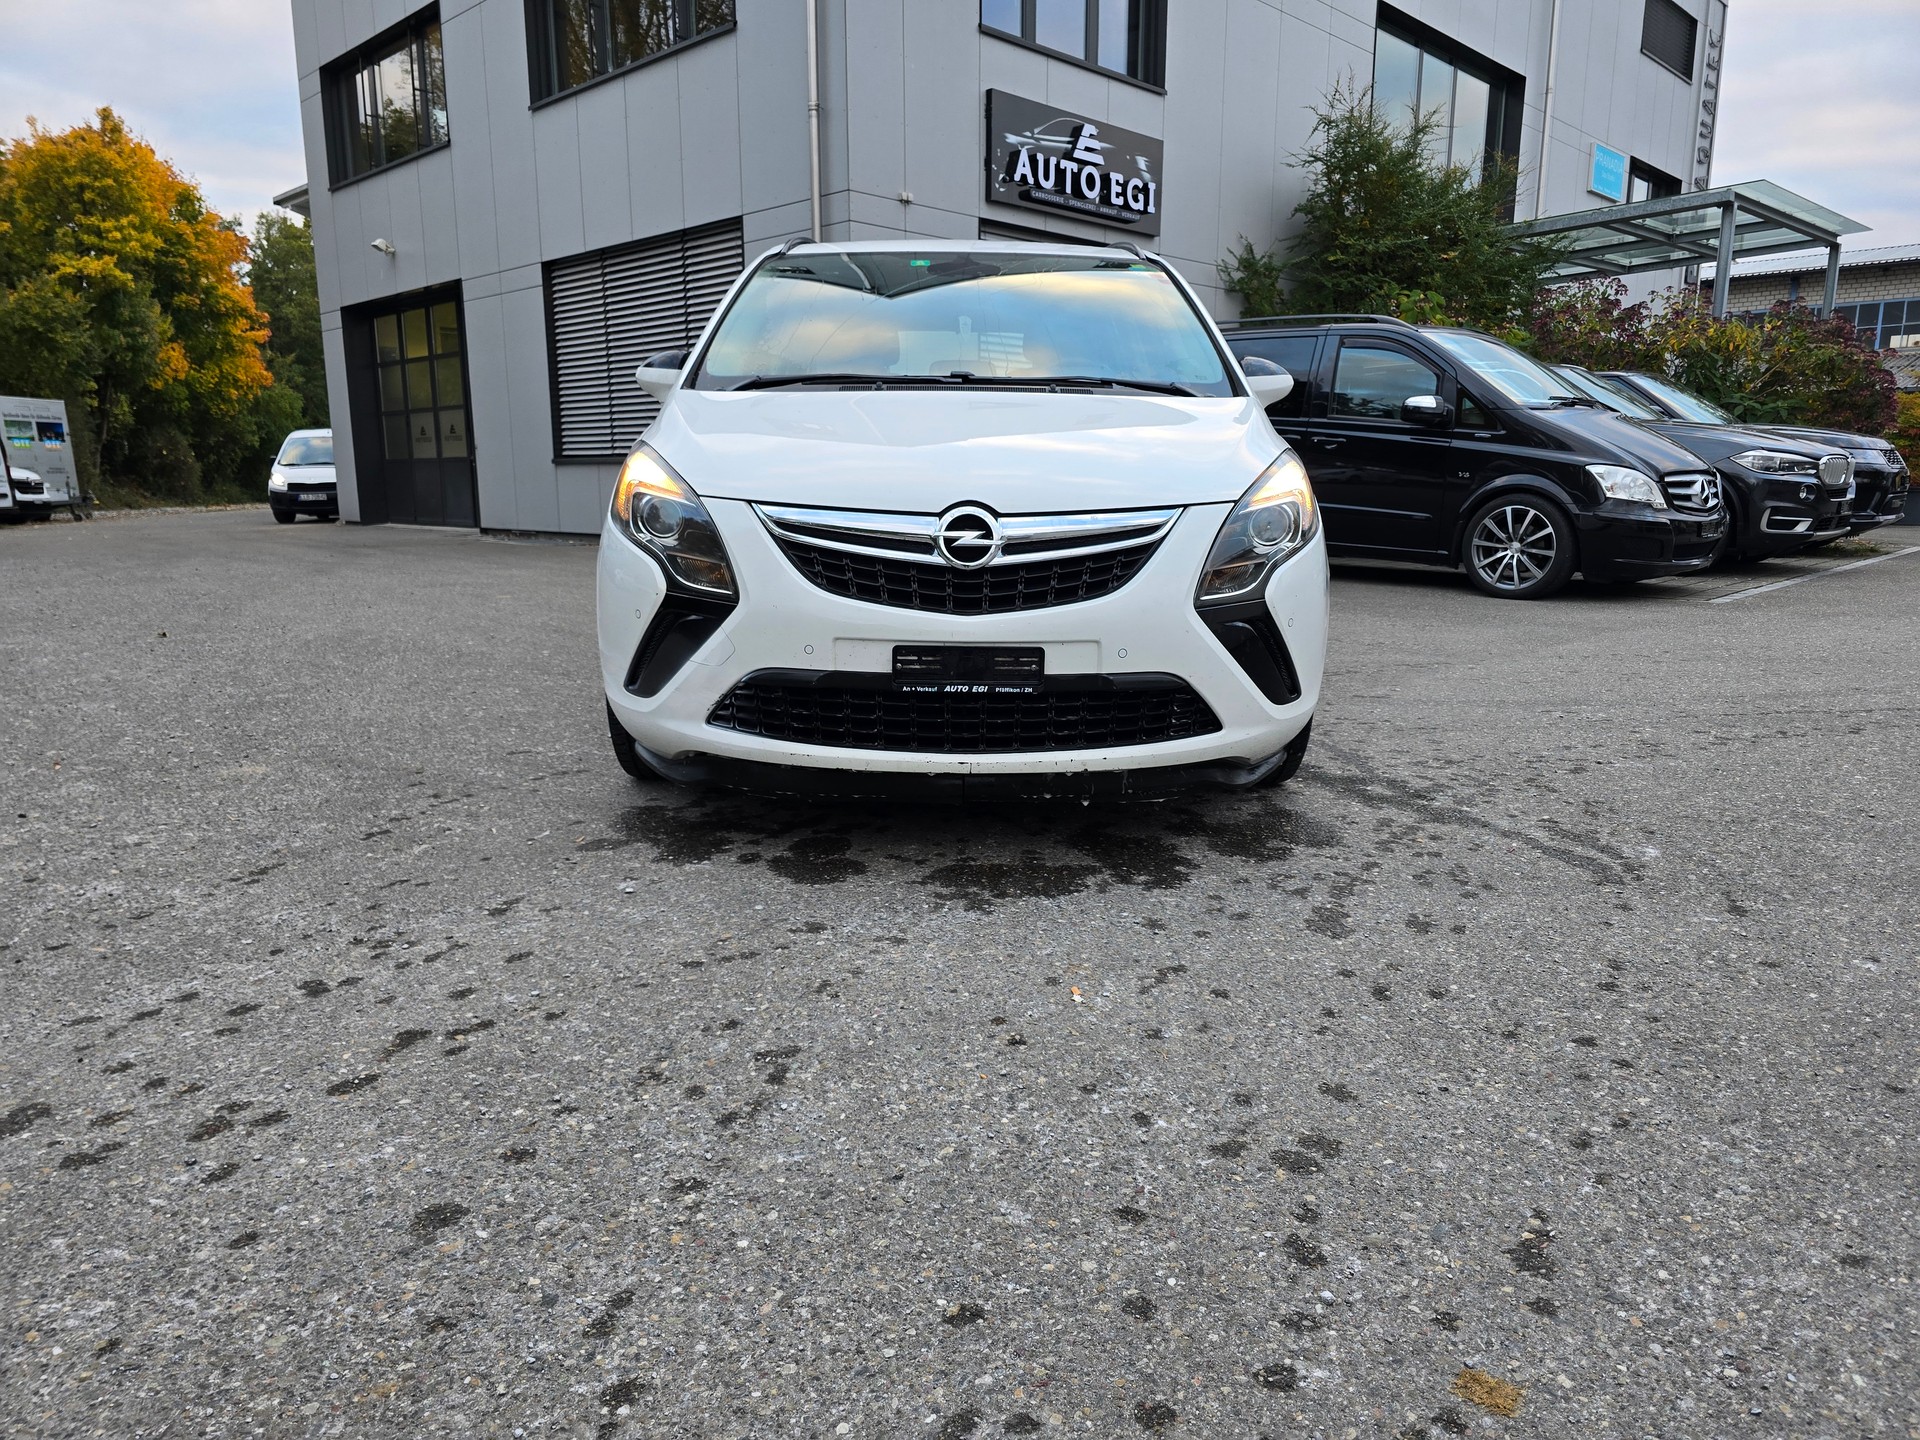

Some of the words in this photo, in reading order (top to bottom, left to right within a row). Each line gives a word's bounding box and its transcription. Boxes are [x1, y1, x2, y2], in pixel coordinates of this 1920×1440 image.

[1694, 29, 1722, 190] AQUATEC
[1014, 147, 1101, 200] AUTO
[1110, 171, 1156, 214] EGI
[1031, 190, 1065, 203] CARROSSERIE
